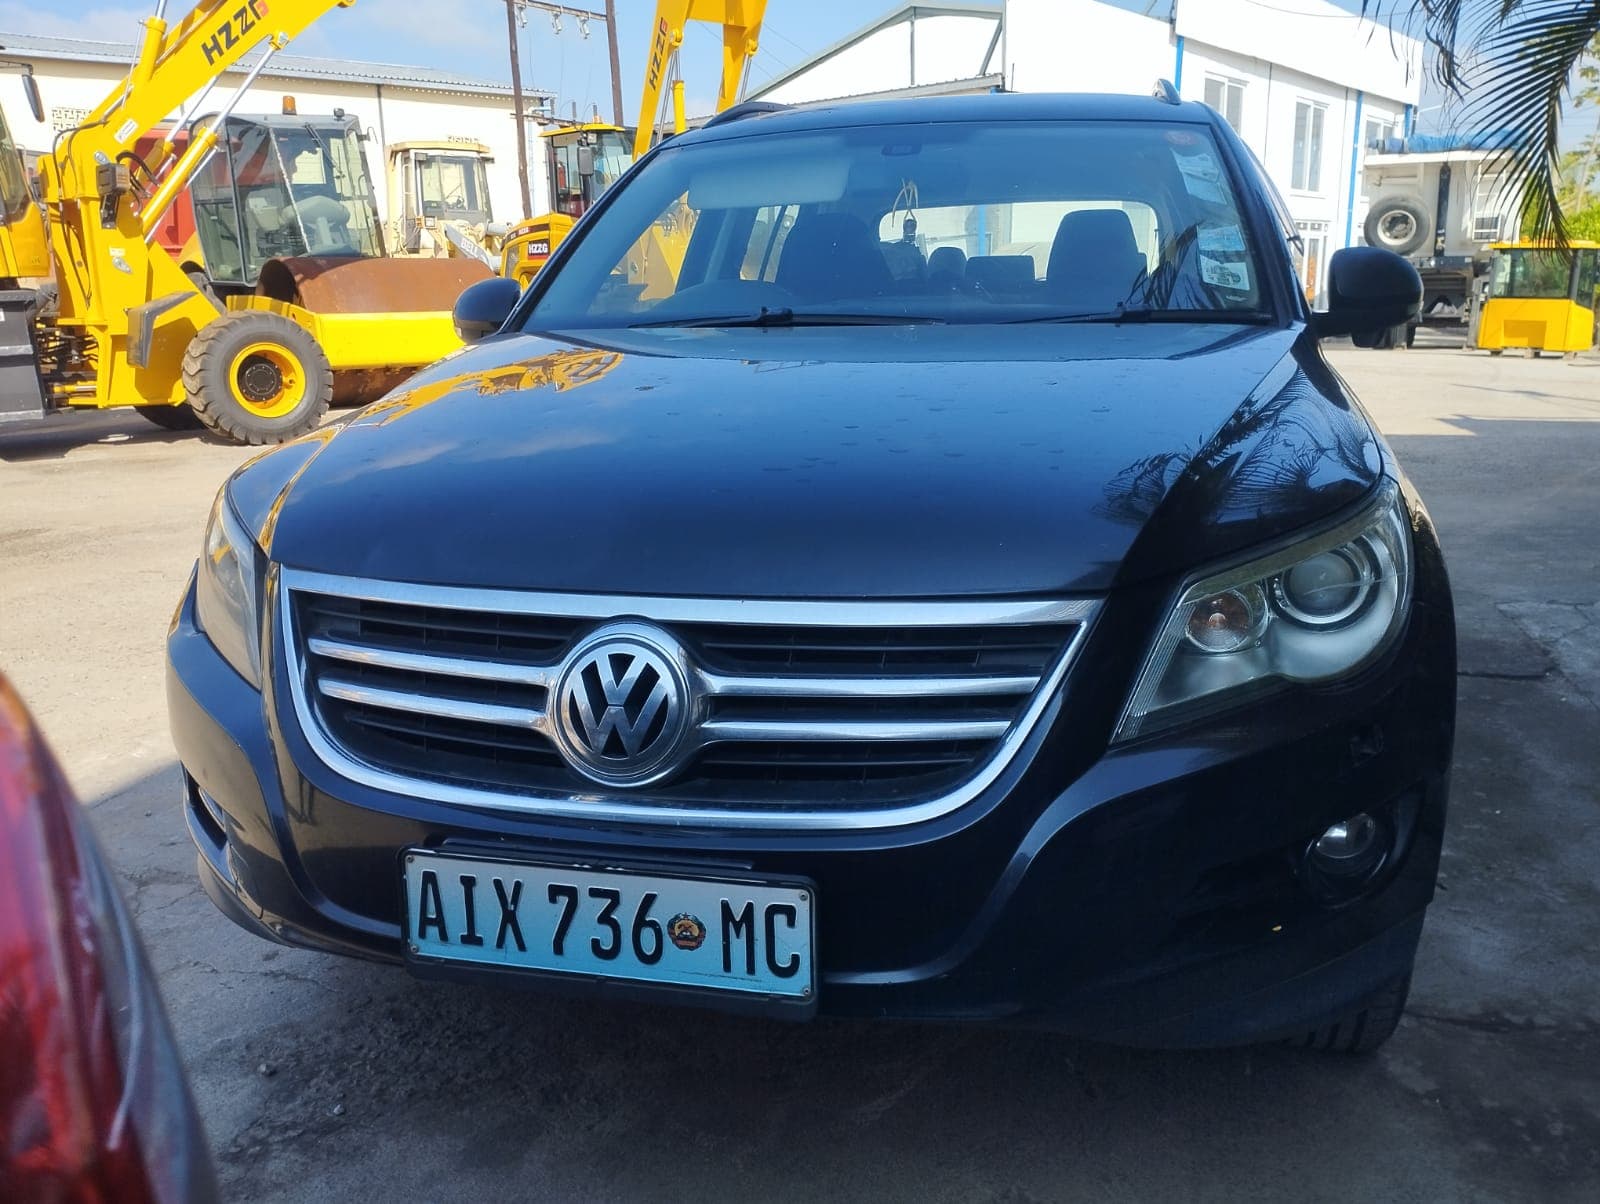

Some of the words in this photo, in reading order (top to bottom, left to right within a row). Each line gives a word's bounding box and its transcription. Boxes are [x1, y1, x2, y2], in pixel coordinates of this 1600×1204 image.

[561, 643, 678, 768] VW
[418, 870, 527, 952] AIX
[547, 883, 664, 965] 736
[720, 897, 801, 978] MC
